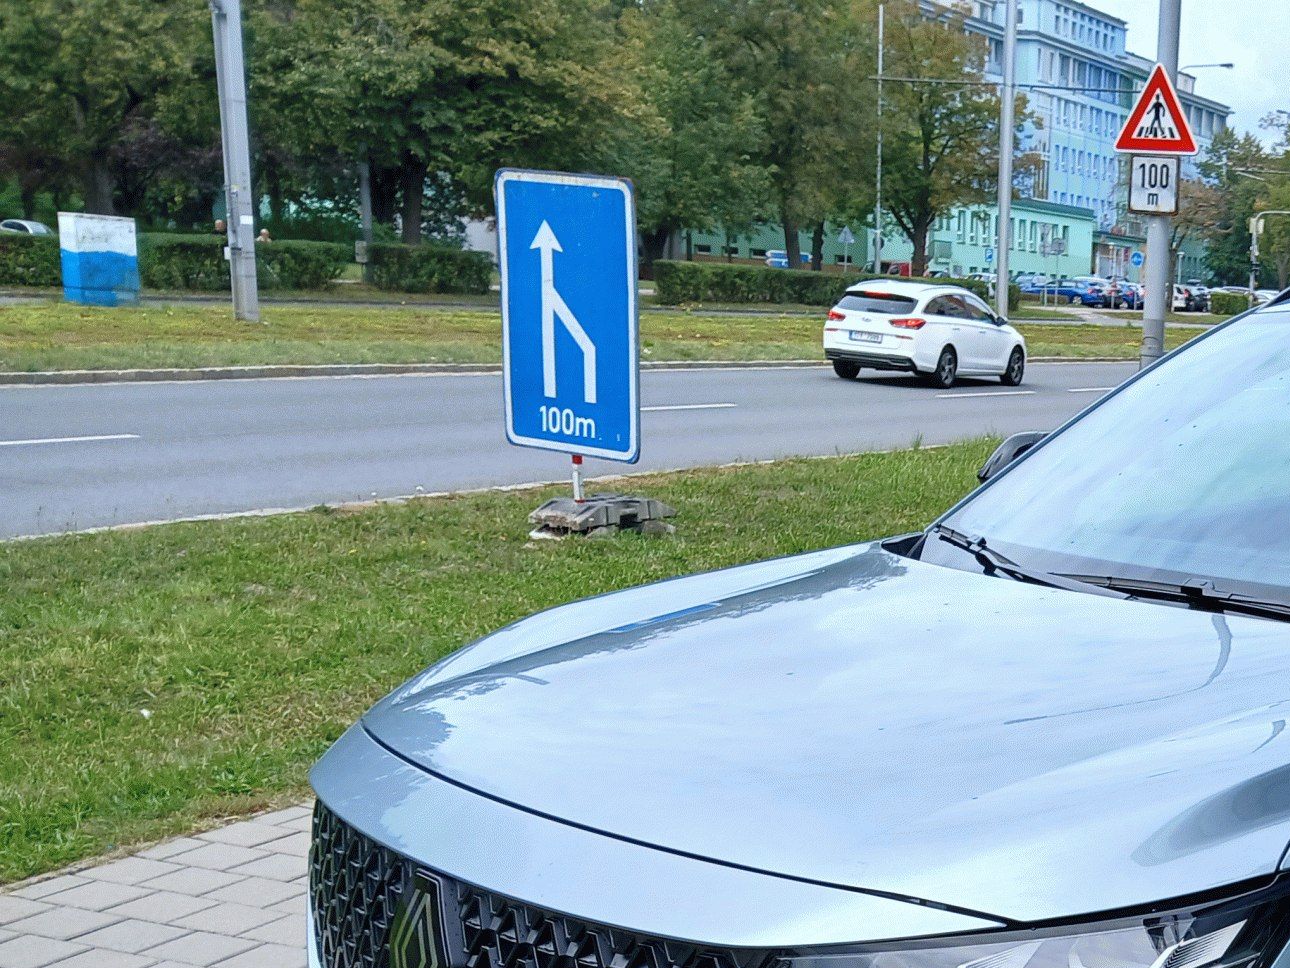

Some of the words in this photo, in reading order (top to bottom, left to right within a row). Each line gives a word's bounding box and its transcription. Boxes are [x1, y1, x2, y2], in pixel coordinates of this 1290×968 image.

[1139, 163, 1170, 189] 100
[1147, 193, 1159, 206] m
[539, 405, 596, 439] 100m
